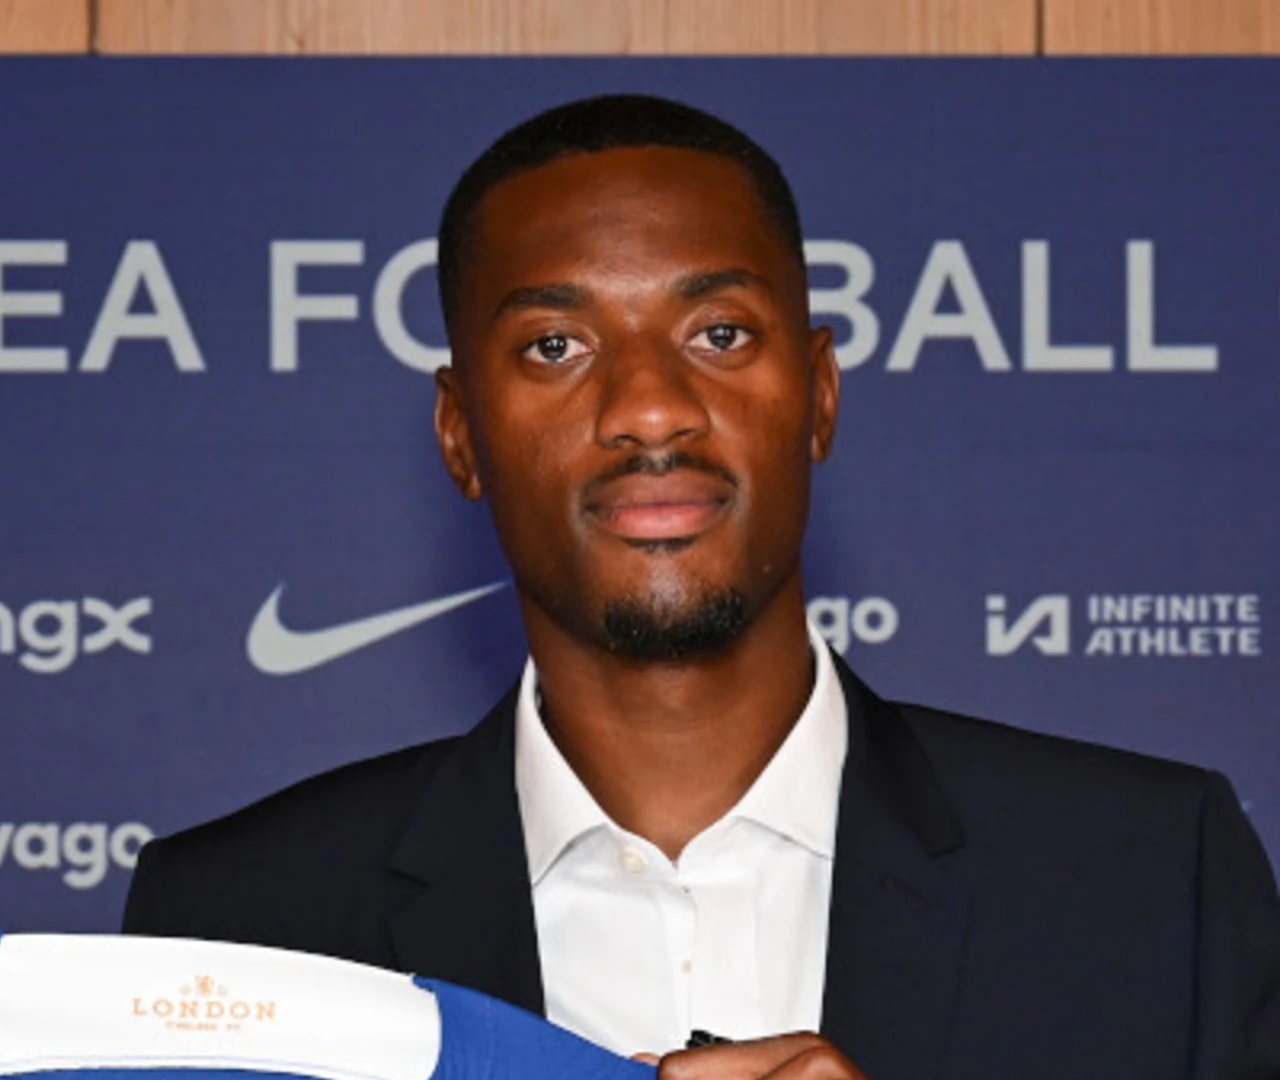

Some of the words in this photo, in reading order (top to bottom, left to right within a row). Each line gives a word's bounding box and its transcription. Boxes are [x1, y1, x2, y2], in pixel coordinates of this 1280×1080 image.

[1089, 595, 1257, 622] INFINITE
[1086, 627, 1259, 655] ATHLETE
[131, 997, 276, 1021] LONDON
